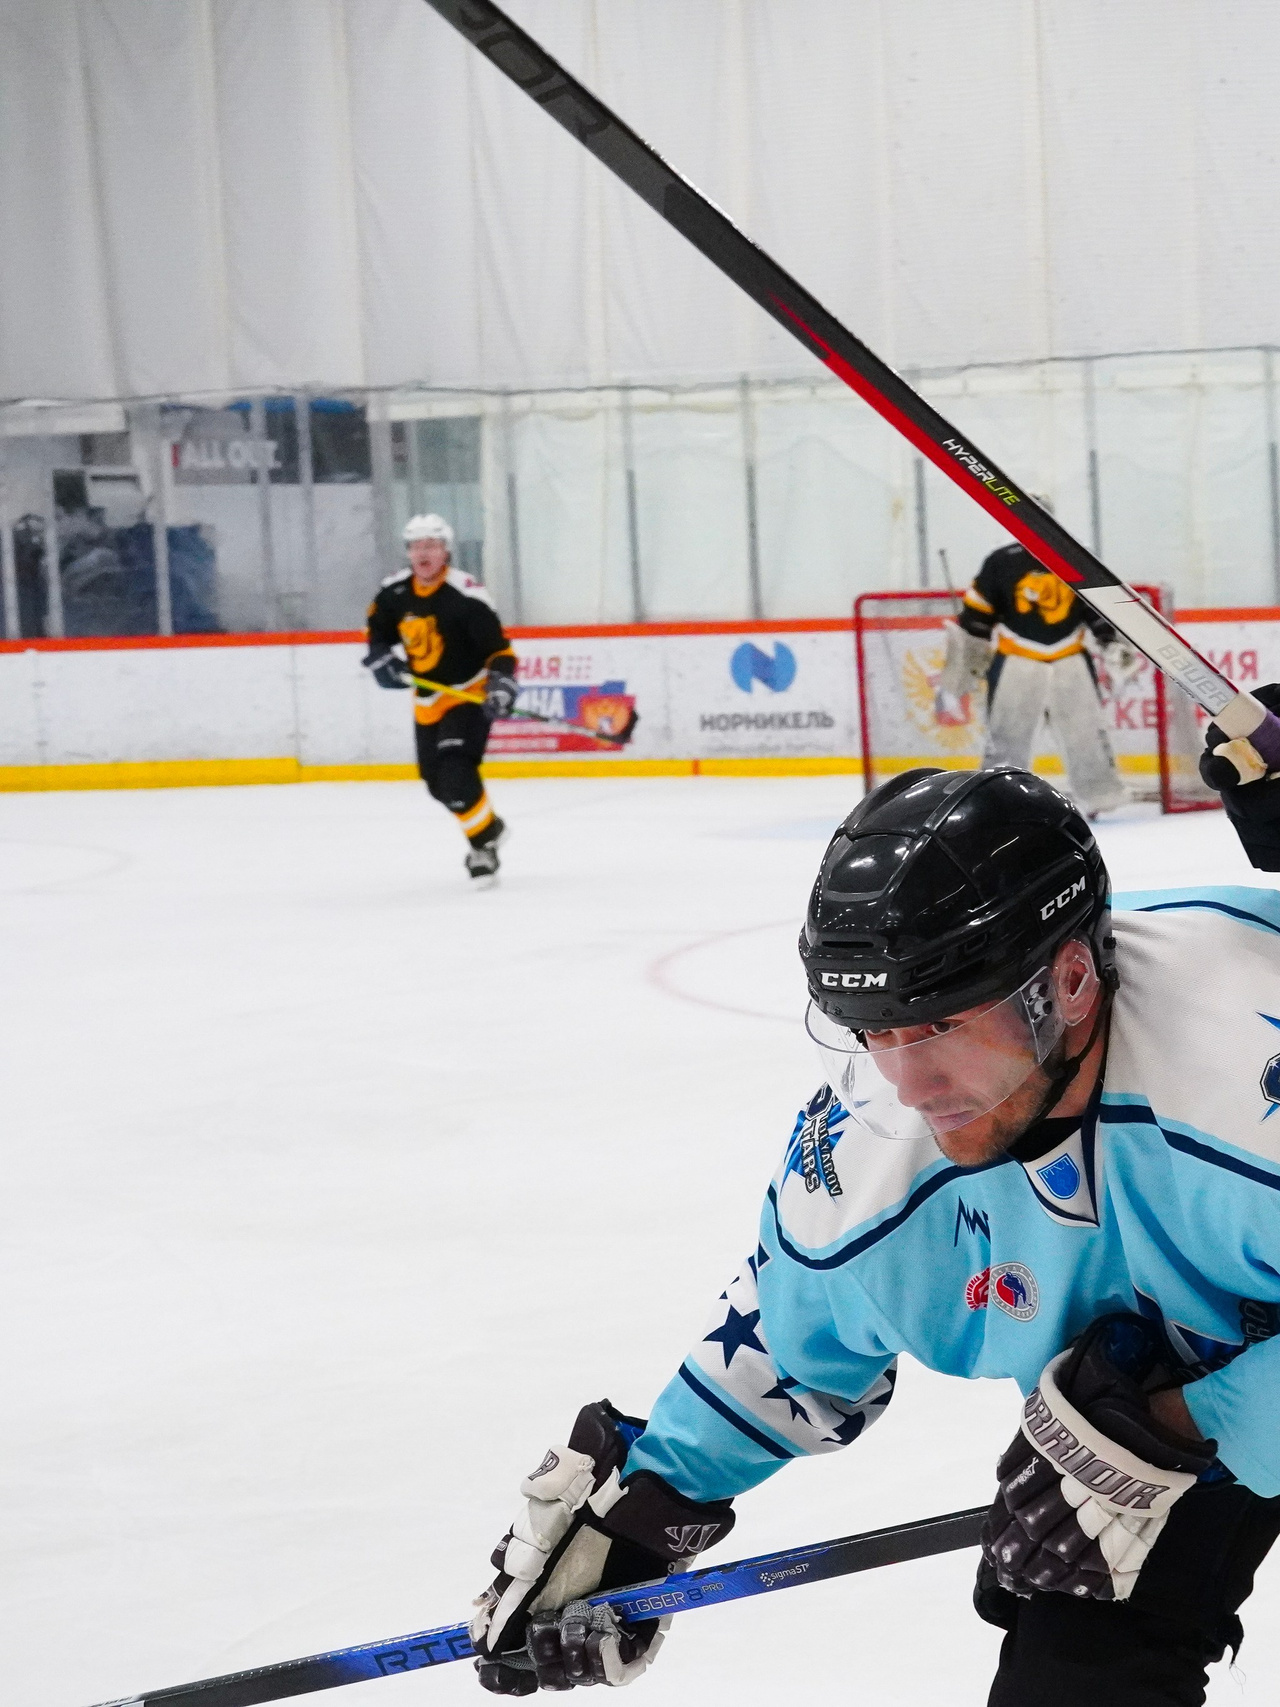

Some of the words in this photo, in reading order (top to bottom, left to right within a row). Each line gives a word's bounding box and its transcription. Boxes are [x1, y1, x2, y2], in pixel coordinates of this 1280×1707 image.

[942, 438, 1021, 506] HYPERLITE
[699, 709, 836, 733] НОРНИКЕЛЬ
[1039, 875, 1087, 922] CCM
[820, 971, 889, 989] CCM
